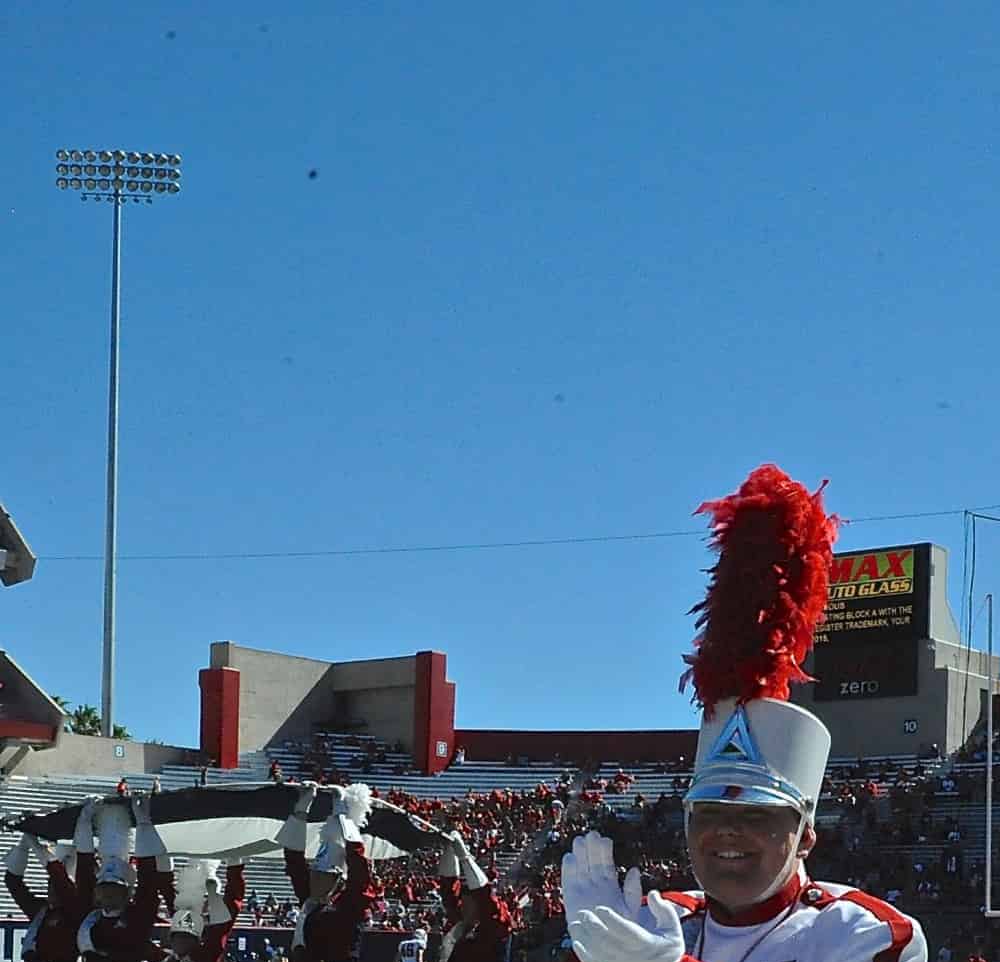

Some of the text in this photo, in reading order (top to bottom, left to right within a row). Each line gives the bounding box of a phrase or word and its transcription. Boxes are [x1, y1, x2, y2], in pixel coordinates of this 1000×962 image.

[828, 579, 911, 600] UTO GLASS
[840, 681, 880, 695] zero
[905, 721, 917, 732] 10
